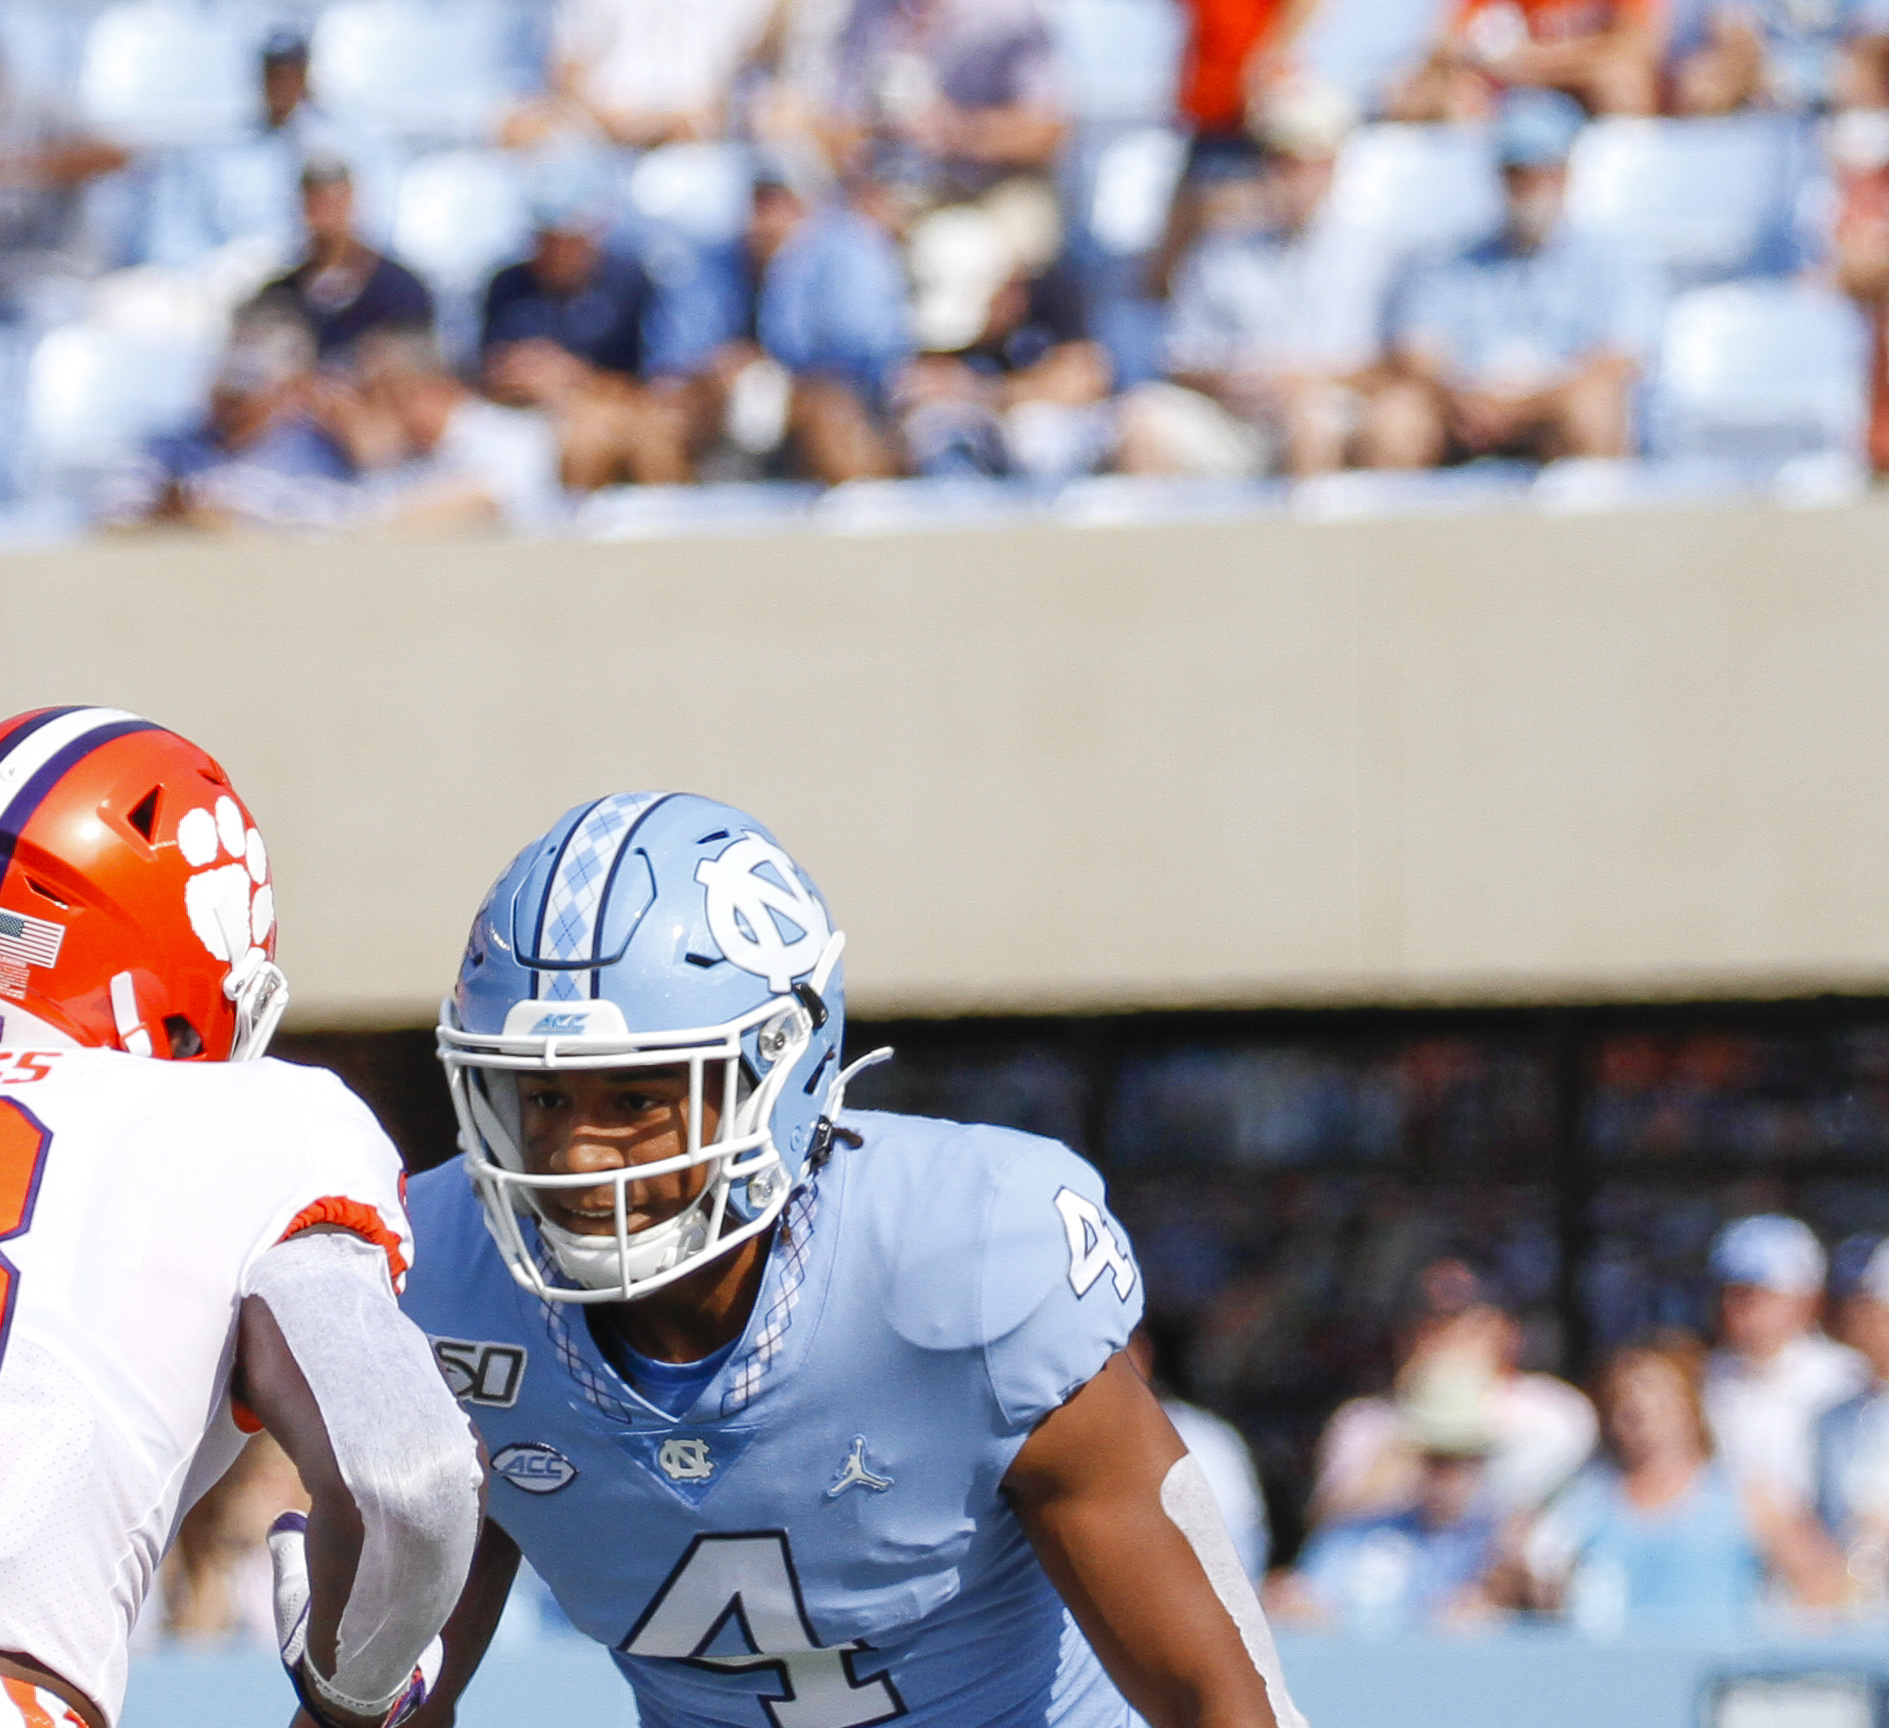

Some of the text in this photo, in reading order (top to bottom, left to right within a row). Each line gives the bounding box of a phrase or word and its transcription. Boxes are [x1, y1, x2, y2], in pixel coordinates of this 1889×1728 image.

[1053, 1185, 1137, 1305] 4
[433, 1340, 524, 1402] 50
[503, 1455, 563, 1478] ACC
